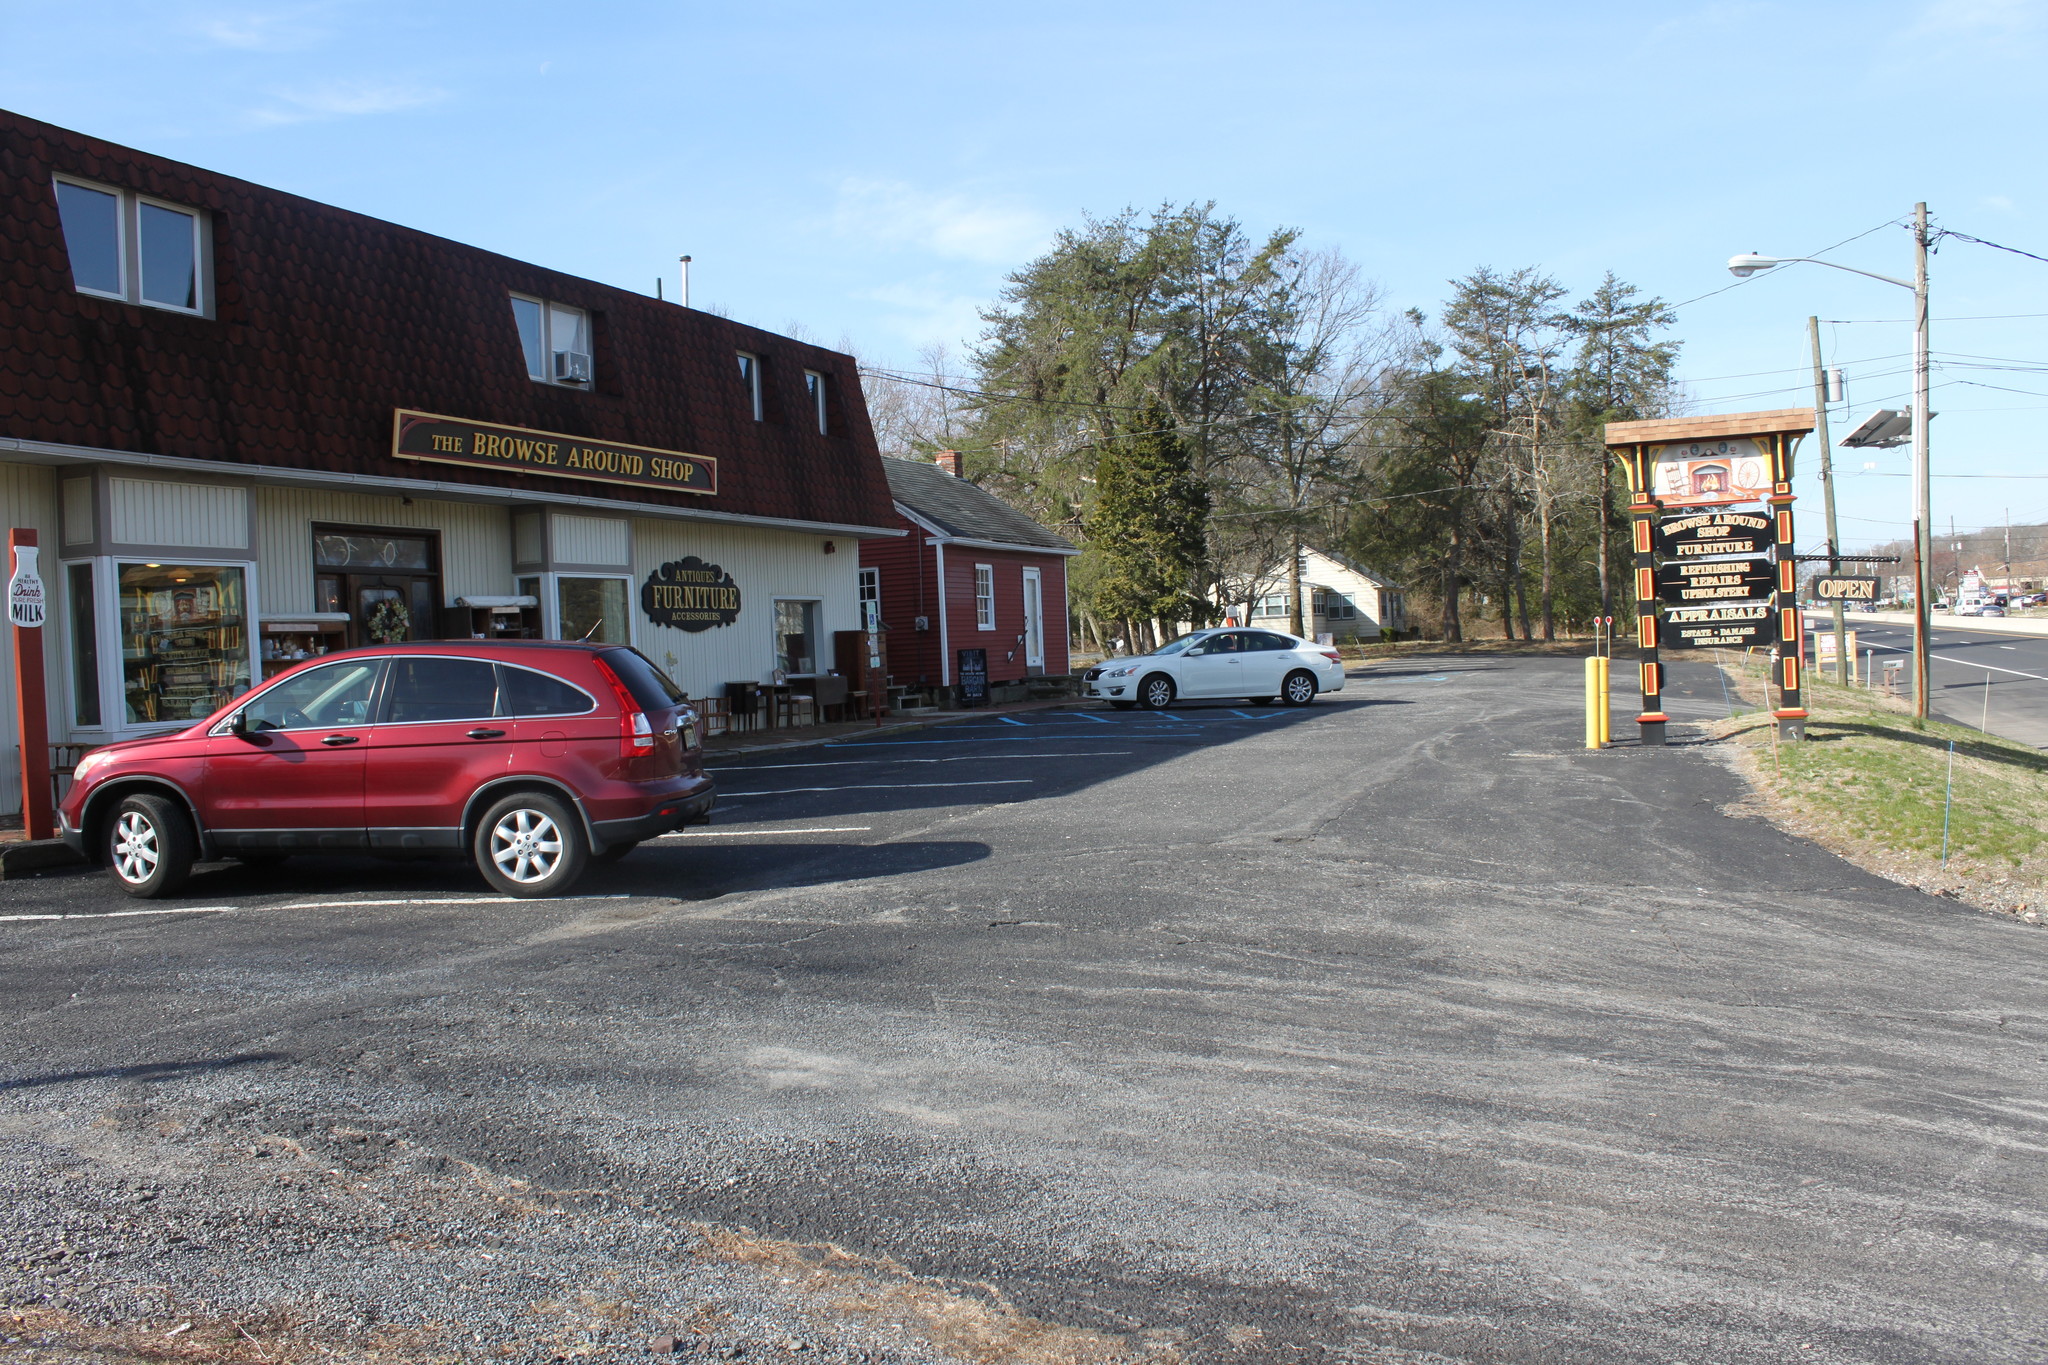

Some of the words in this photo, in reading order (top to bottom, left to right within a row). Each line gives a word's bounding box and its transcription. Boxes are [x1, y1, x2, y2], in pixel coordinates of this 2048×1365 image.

[432, 435, 462, 453] THE
[472, 432, 559, 465] BROWSE
[565, 447, 644, 475] AROUND
[650, 457, 694, 482] SHOP
[1661, 515, 1711, 536] BROWSE
[1714, 514, 1767, 529] AROUND
[1697, 526, 1731, 538] SHOP
[1676, 540, 1754, 555] FURNITURE
[675, 569, 715, 583] ANTIQUES
[1680, 562, 1751, 576] REFINISHING
[1690, 575, 1742, 587] REPAIRS
[13, 583, 41, 597] Drink
[1681, 586, 1751, 600] UPHOLSTERY
[1818, 579, 1875, 599] OPEN
[652, 585, 737, 610] FURNITURE
[12, 603, 43, 622] MILK
[671, 612, 721, 621] ACCESSORIES
[1668, 607, 1767, 623] APPRAISALS
[1680, 628, 1712, 638] ESTATE
[1719, 627, 1756, 636] DAMAGE
[1694, 636, 1743, 645] INSURANCE
